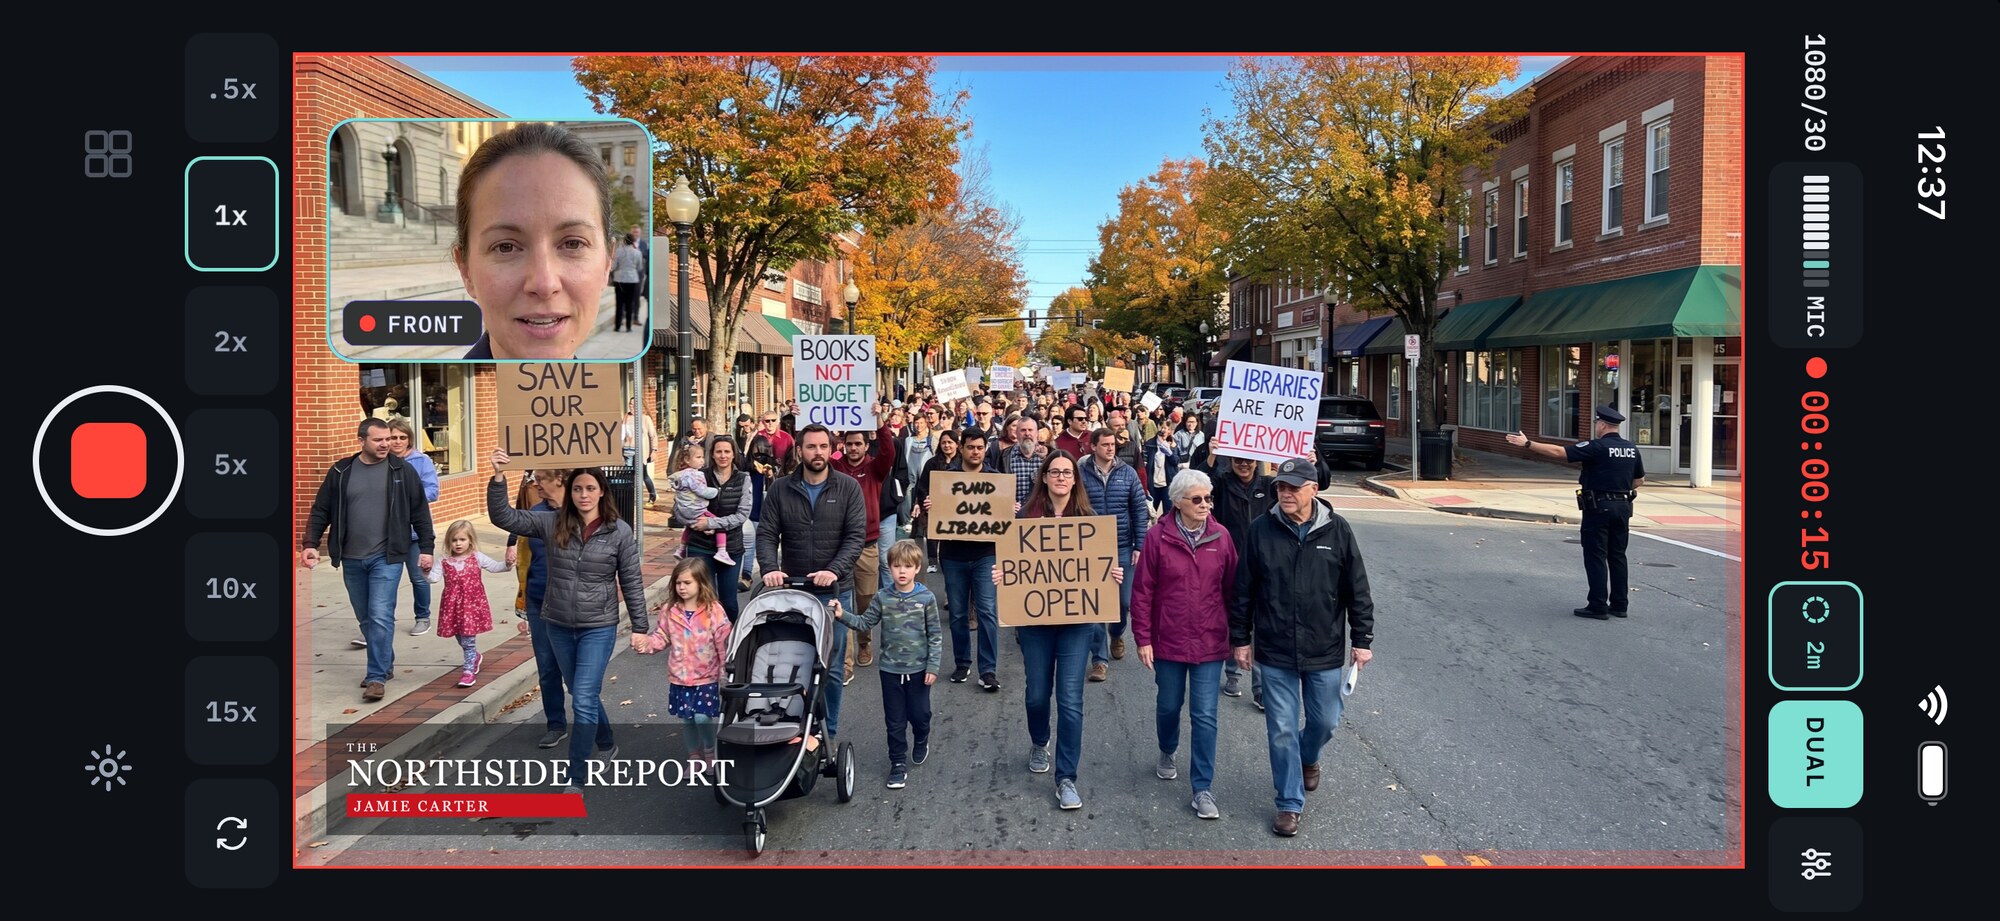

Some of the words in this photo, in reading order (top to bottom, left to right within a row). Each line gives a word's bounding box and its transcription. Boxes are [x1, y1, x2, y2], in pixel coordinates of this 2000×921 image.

[210, 78, 257, 100] .5x
[1800, 33, 1828, 152] 1080/30
[1917, 125, 1947, 220] 12:37
[214, 204, 248, 226] 1x
[388, 315, 464, 334] FRONT
[1806, 296, 1825, 338] MIC
[214, 330, 248, 352] 2x
[800, 339, 870, 362] BOOKS
[517, 362, 599, 391] SAVE
[815, 363, 855, 381] NOT
[1228, 366, 1320, 401] LIBRARIES
[799, 383, 872, 403] BUDGET
[531, 394, 584, 418] OUR
[809, 405, 862, 427] CUTS
[1231, 398, 1265, 417] ARE
[1273, 402, 1304, 422] FOR
[505, 421, 618, 457] LIBRARY
[1217, 419, 1313, 457] EVERYONE
[214, 453, 248, 475] 5x
[1608, 447, 1636, 459] POLICE
[951, 481, 996, 496] FUND
[1800, 390, 1830, 571] 00:00:15
[956, 500, 992, 516] OUR
[935, 520, 1012, 536] LIBRARY
[1018, 522, 1096, 554] KEEP
[1001, 556, 1090, 587] BRANCH
[1097, 556, 1114, 583] 7
[205, 577, 257, 599] 10x
[1023, 588, 1099, 618] OPEN
[1806, 641, 1825, 669] 2m
[205, 701, 257, 723] 15x
[1805, 717, 1825, 787] DUAL
